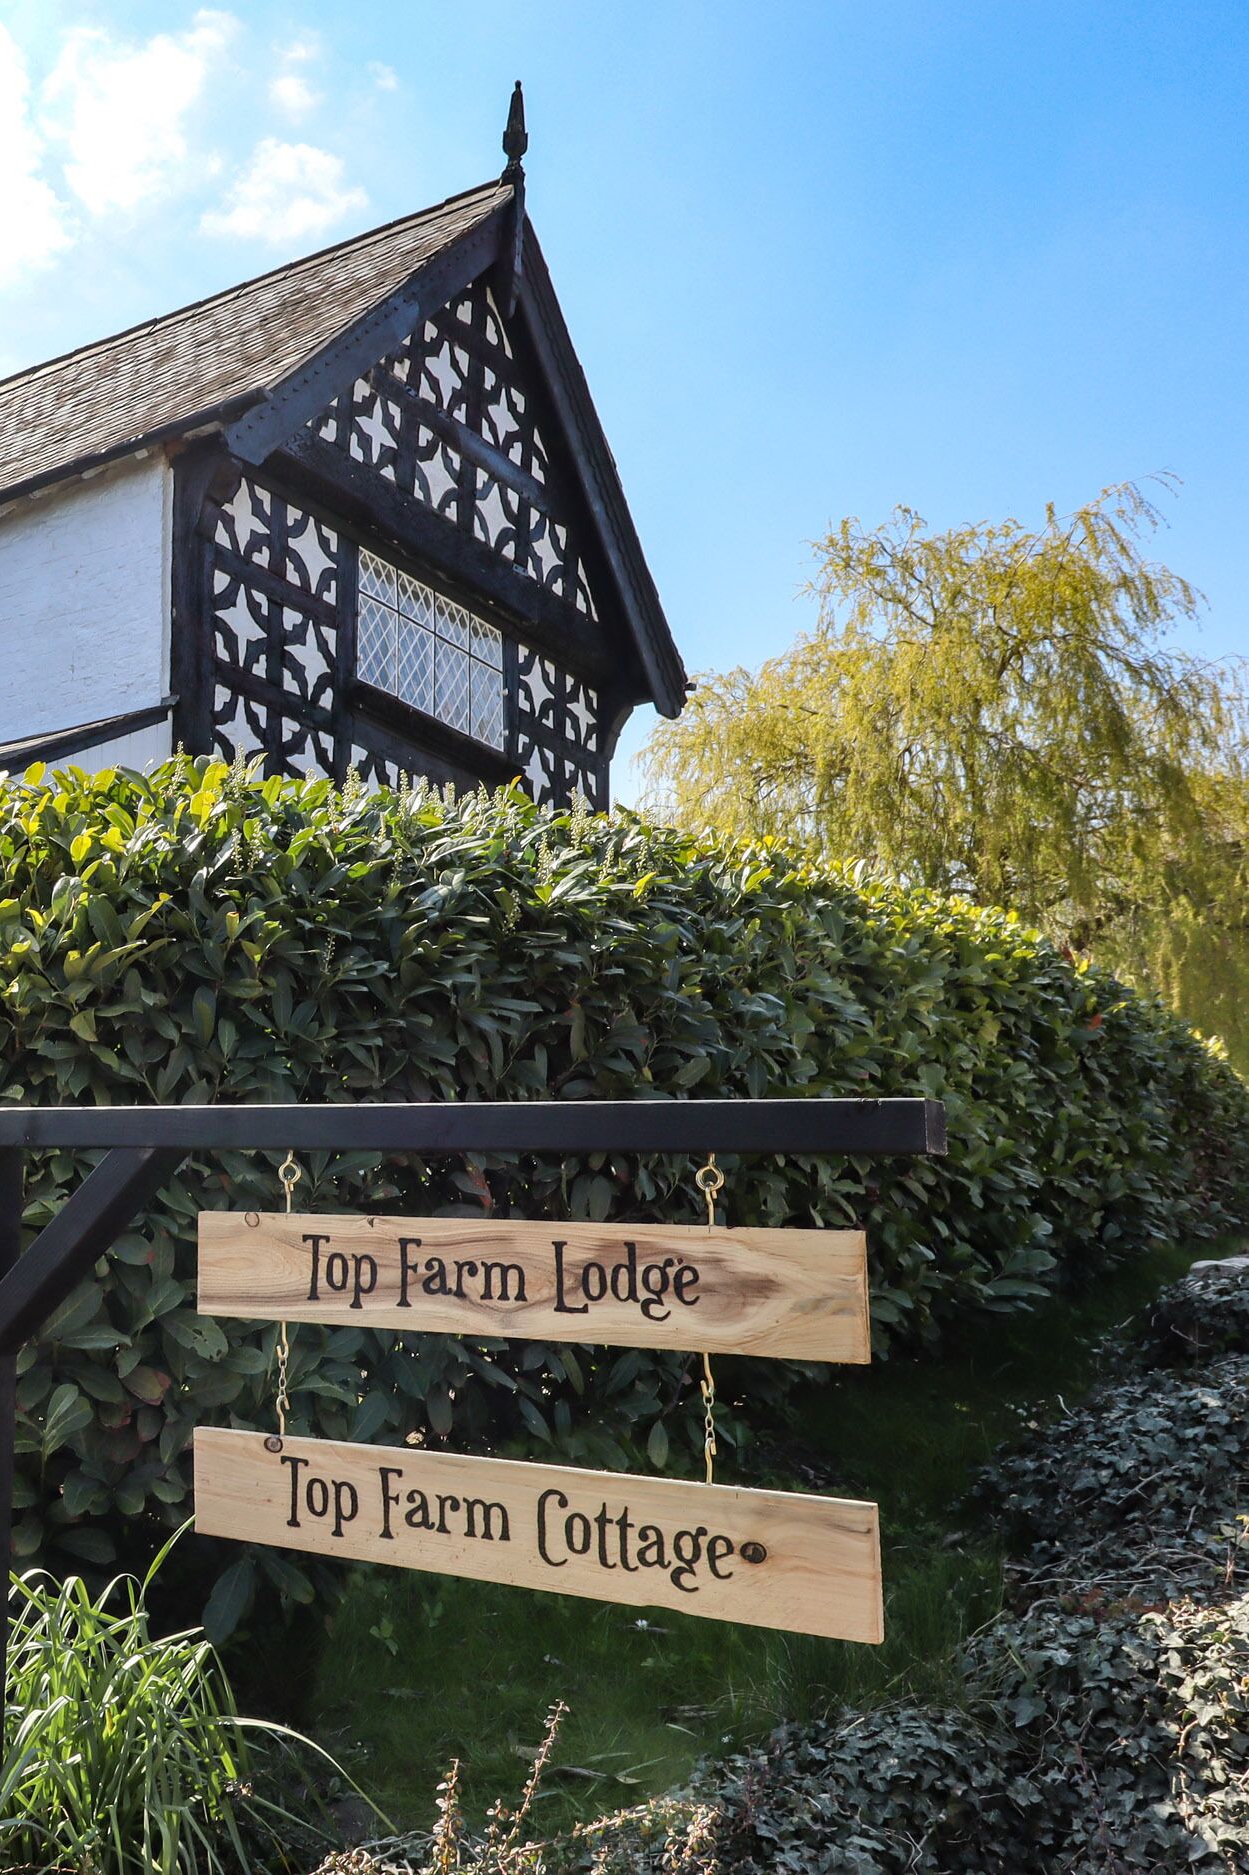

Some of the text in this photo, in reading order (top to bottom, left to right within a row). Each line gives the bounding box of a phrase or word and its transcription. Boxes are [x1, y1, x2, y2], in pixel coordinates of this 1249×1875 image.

[302, 1234, 700, 1321] Top Farm Lodge
[280, 1456, 734, 1593] Top Farm Cottage
